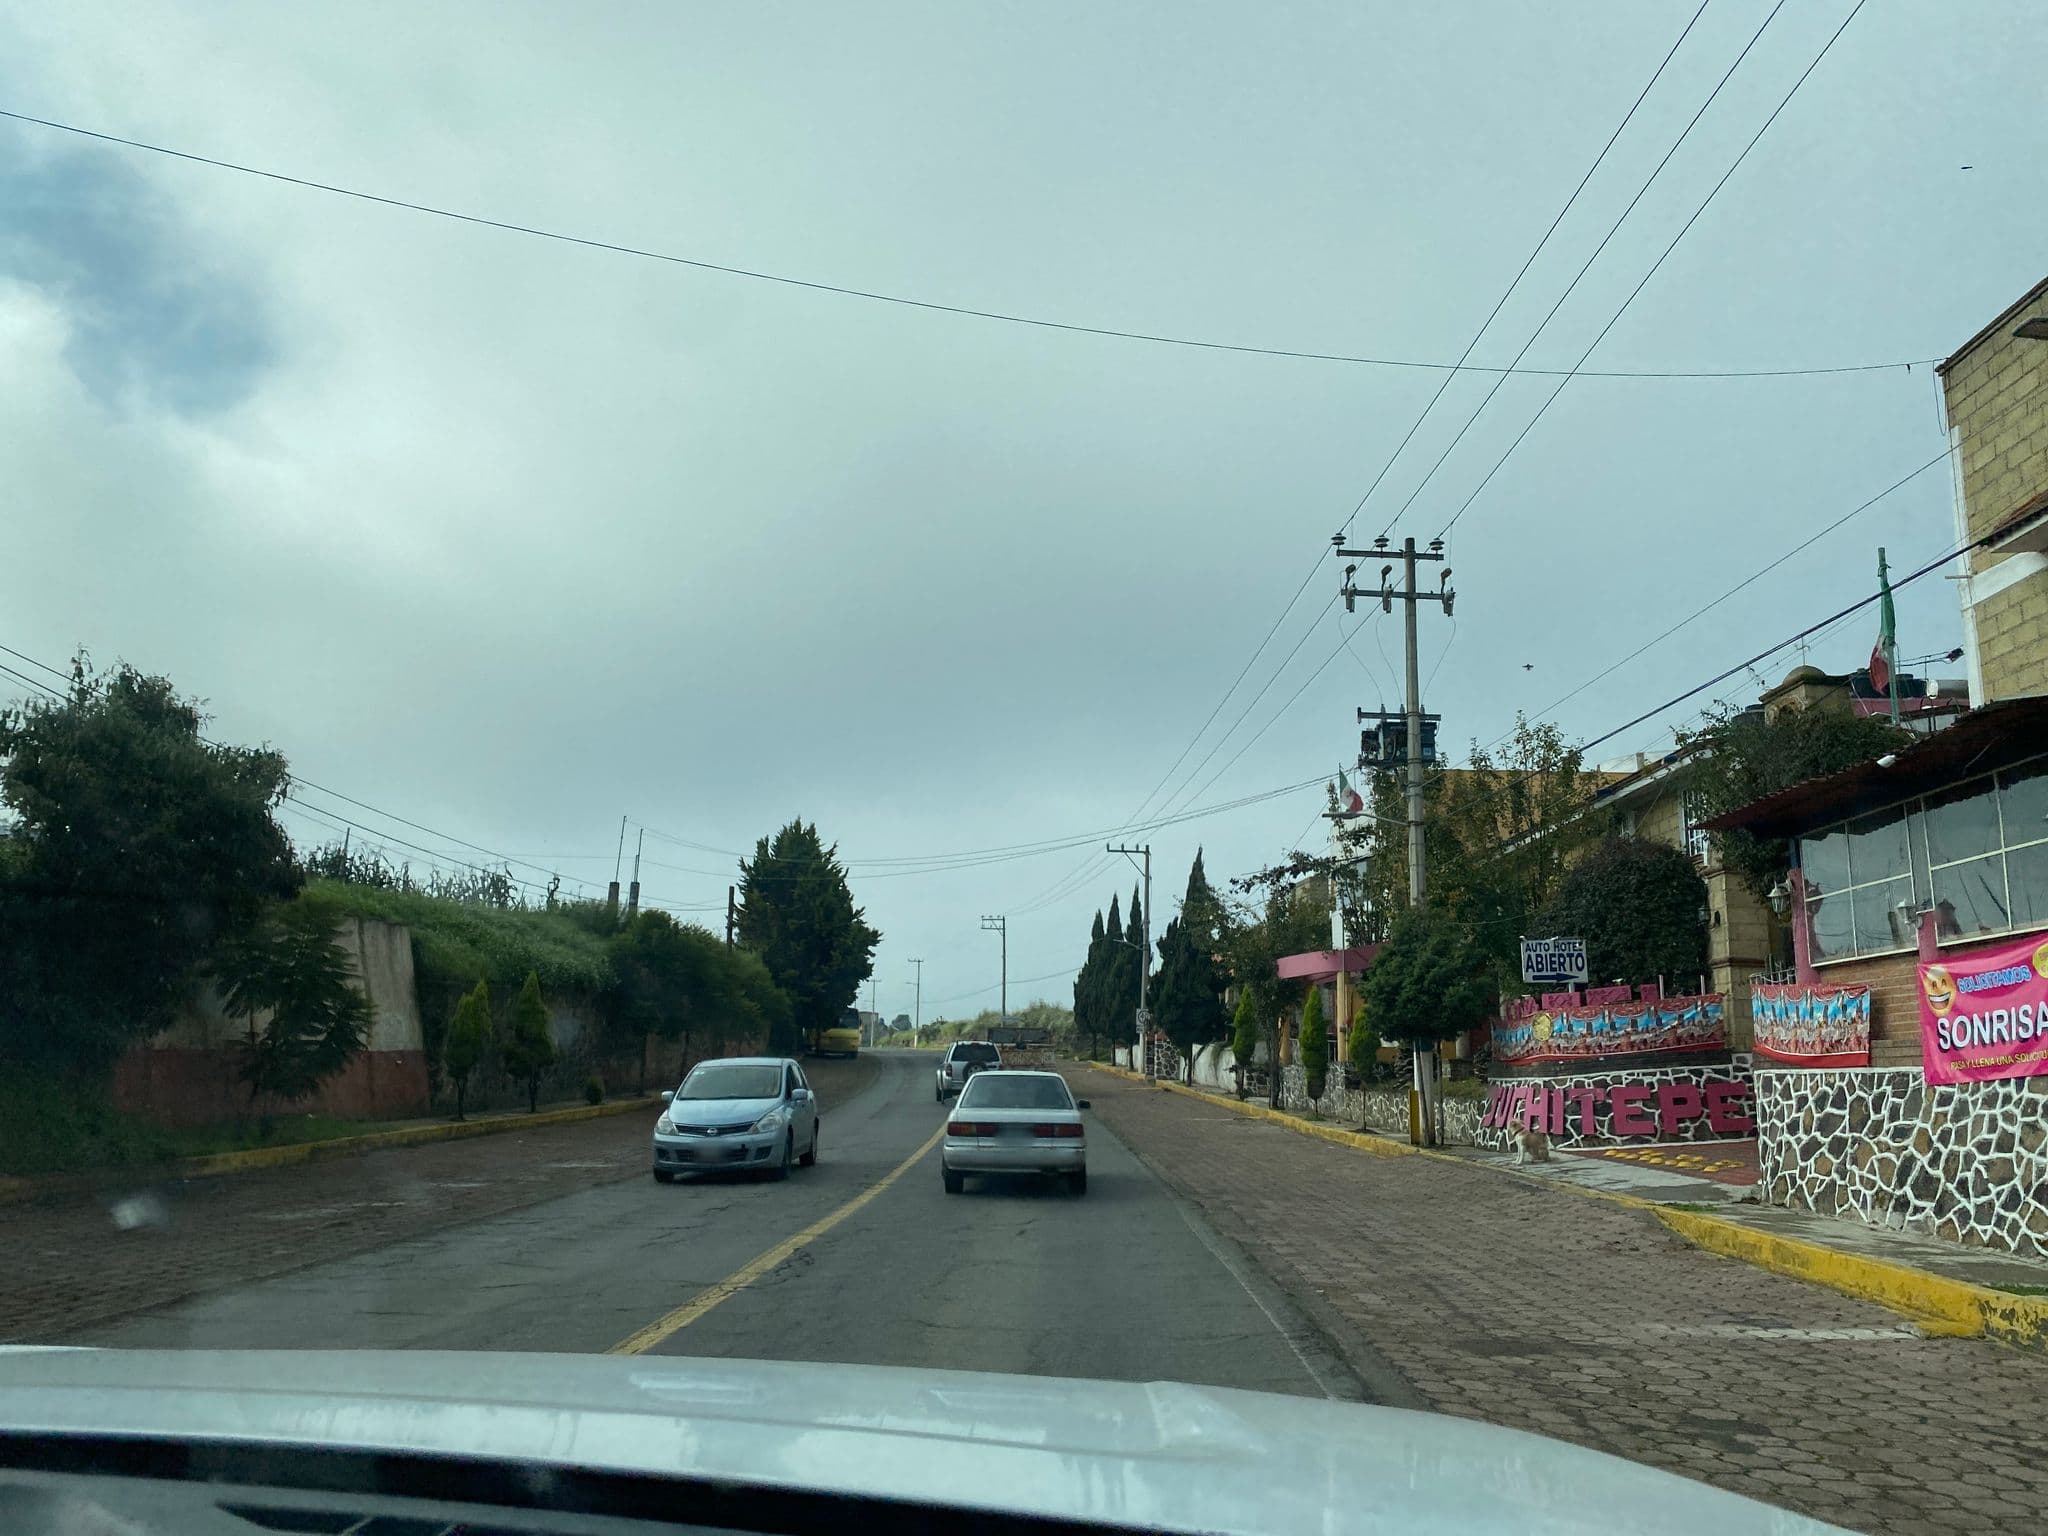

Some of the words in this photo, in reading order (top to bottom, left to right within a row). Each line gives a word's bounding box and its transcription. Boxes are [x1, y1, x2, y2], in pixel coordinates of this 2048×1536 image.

[1526, 942, 1550, 952] AUTO
[1554, 941, 1583, 952] HOTEL
[1526, 953, 1585, 972] ABIERTO
[1957, 965, 2032, 993] SOLICITAMOS
[1972, 1057, 1995, 1068] LLENA
[1997, 1055, 2014, 1065] UNA
